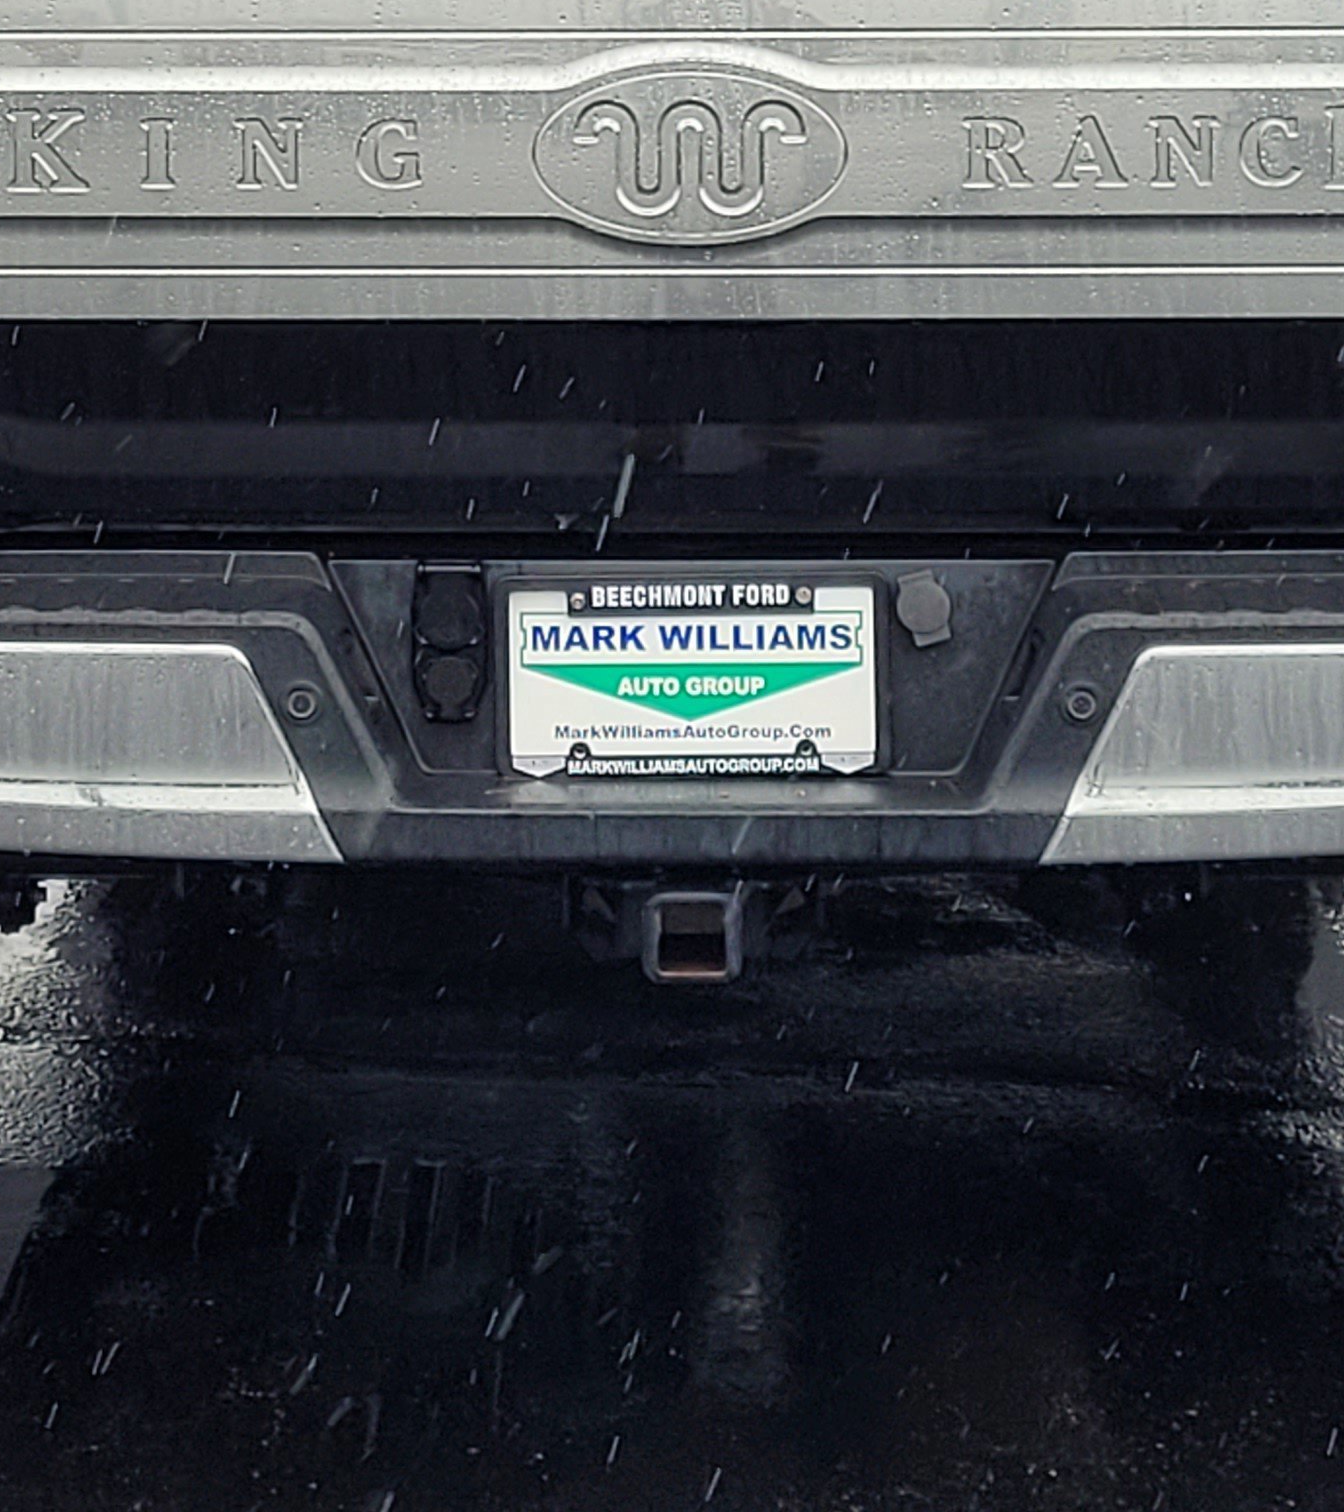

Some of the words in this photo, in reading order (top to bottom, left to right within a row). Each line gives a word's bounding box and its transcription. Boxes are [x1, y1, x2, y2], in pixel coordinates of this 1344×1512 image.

[5, 108, 424, 195] KING
[590, 585, 724, 609] BEECHMONT
[732, 584, 791, 606] FORD
[531, 625, 646, 651] MARK
[658, 623, 853, 651] WILLIAMS
[616, 676, 680, 697] AUTO
[685, 675, 766, 696] GROUP
[554, 723, 832, 741] MarkWilliamsAutoGroup.Com
